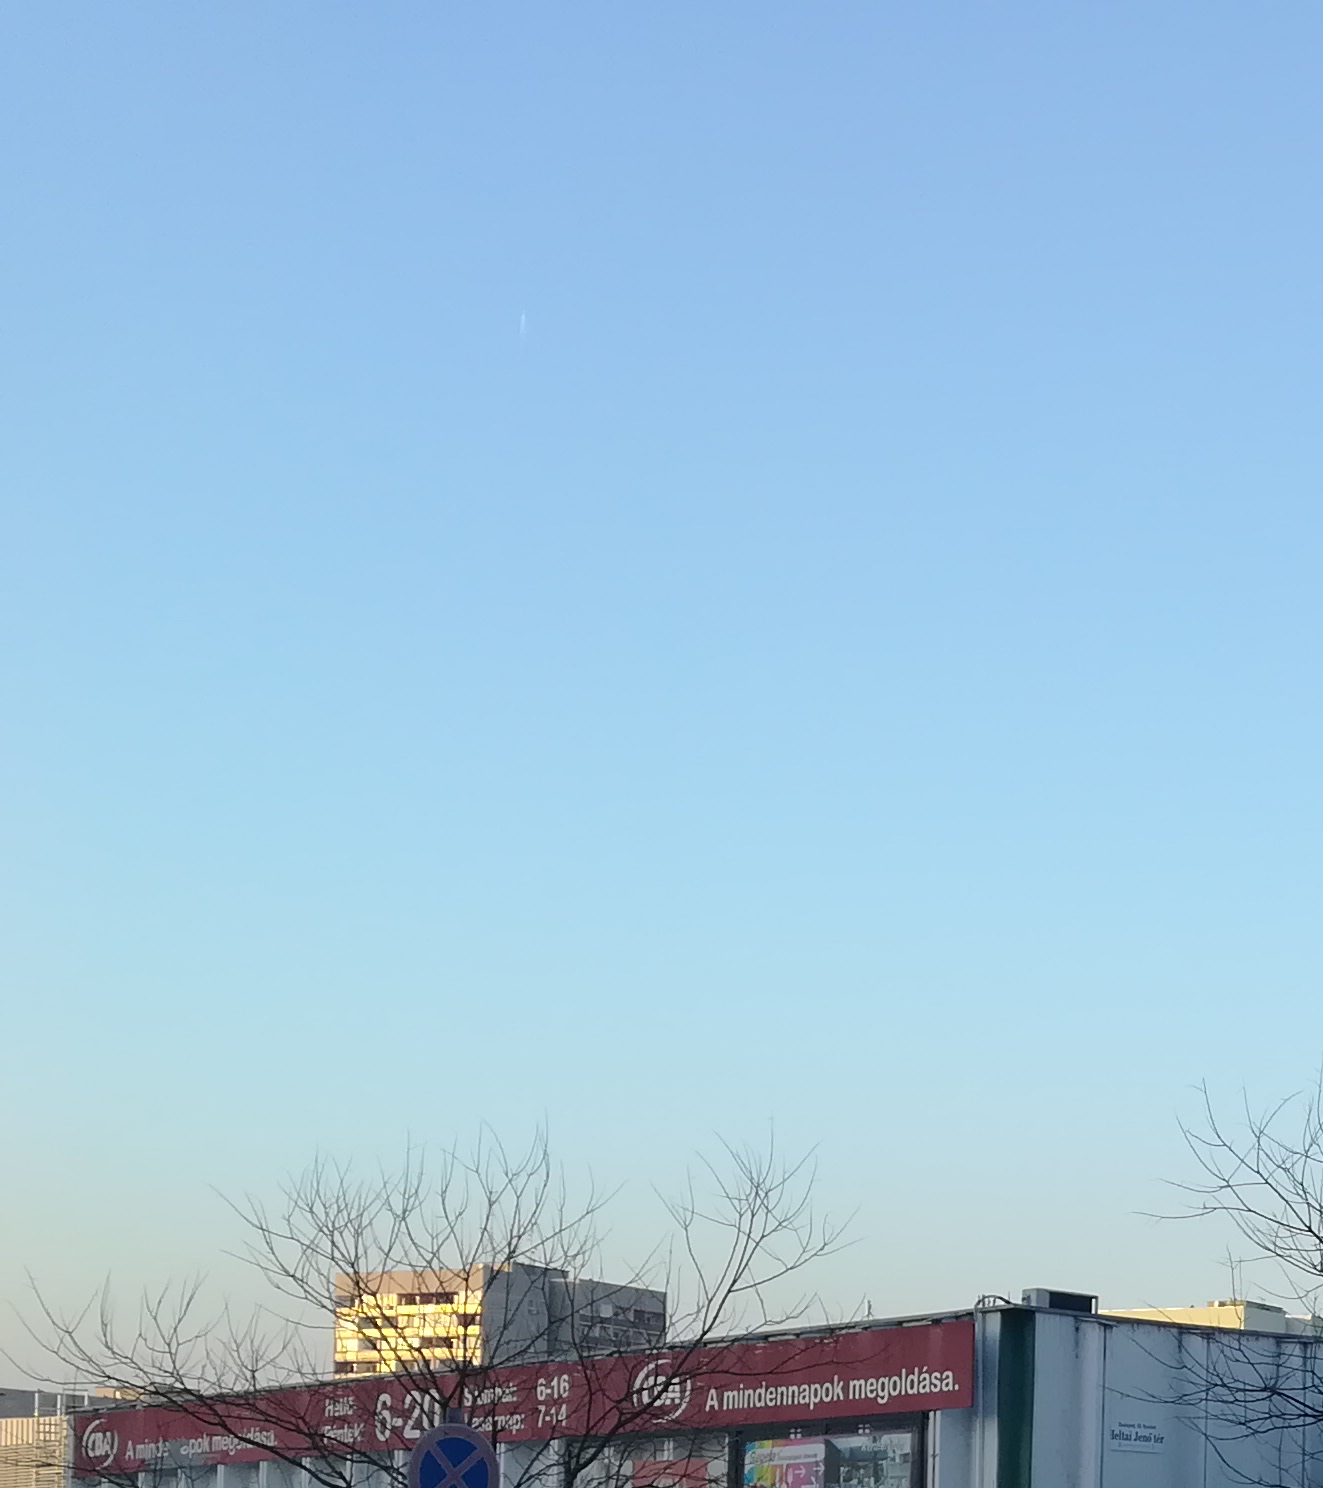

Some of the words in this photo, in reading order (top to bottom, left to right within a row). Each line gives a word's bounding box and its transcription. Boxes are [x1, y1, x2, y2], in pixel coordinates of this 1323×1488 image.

[536, 1374, 570, 1401] 6-16
[705, 1388, 719, 1412] A
[722, 1374, 844, 1411] mindennapok
[848, 1365, 960, 1406] megoldása.
[374, 1387, 442, 1442] 6-20
[537, 1403, 567, 1428] 7-14
